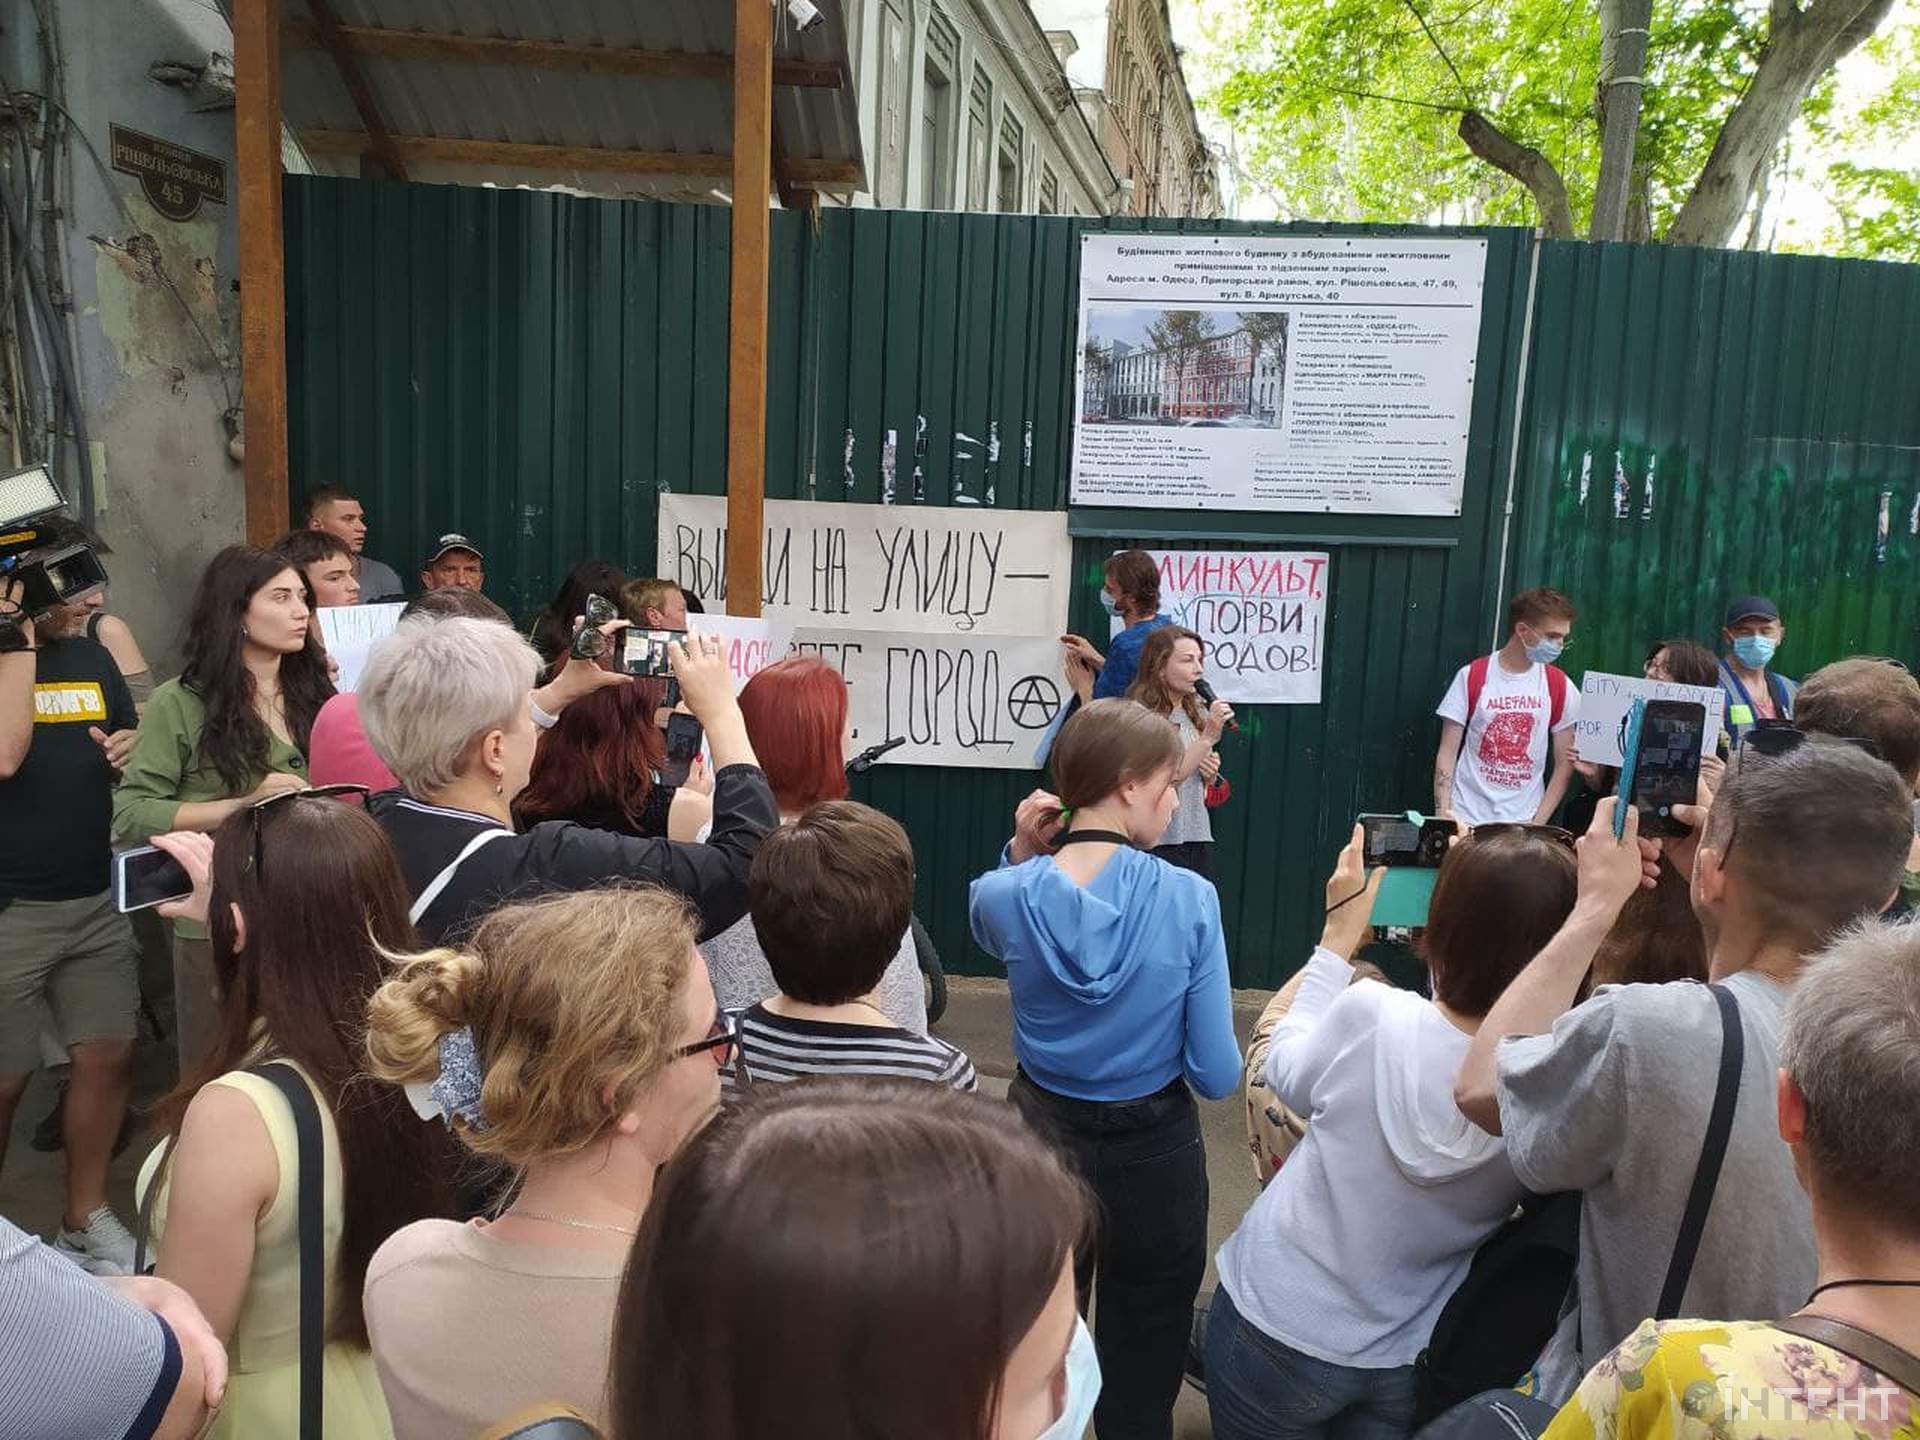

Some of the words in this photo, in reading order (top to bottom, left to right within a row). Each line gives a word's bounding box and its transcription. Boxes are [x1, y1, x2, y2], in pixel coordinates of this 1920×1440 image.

[160, 181, 185, 205] 45
[1117, 246, 1181, 257] Будівництво
[1106, 274, 1144, 285] Адреса
[1201, 276, 1274, 287] Приморський
[676, 525, 791, 606] ВЫИ
[811, 527, 850, 614] НА
[1194, 598, 1304, 636] ПОРВИ
[1584, 676, 1621, 697] CITY
[884, 646, 1014, 754] ГОРОД
